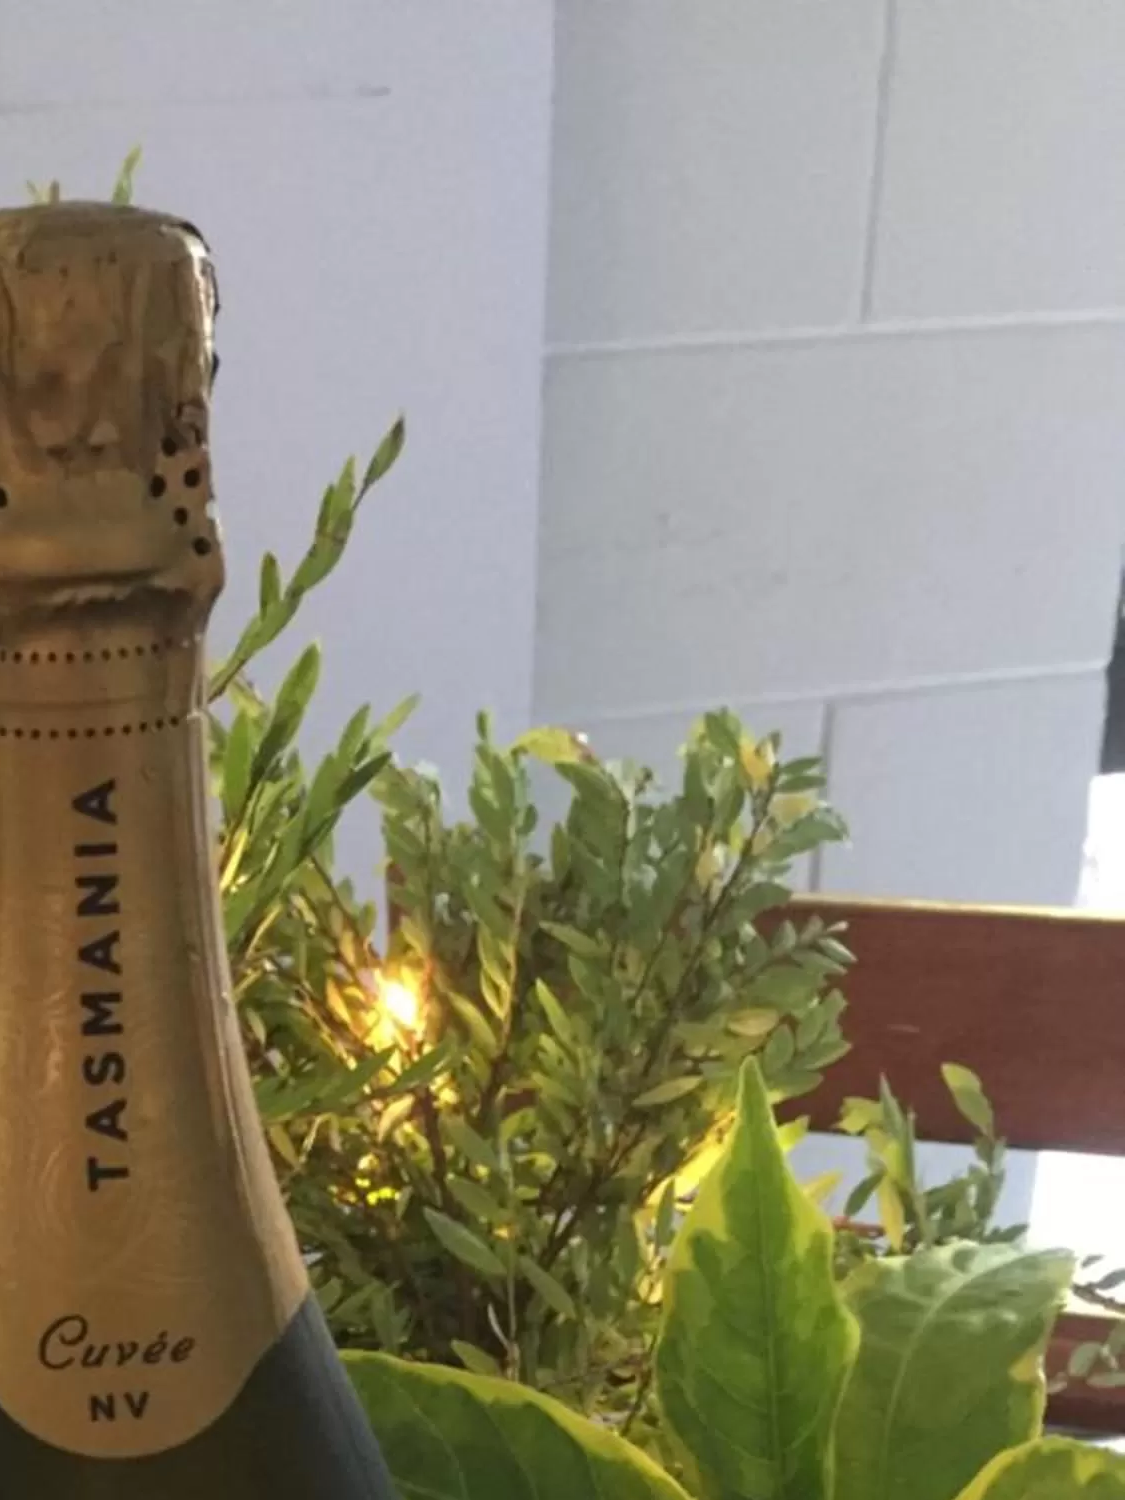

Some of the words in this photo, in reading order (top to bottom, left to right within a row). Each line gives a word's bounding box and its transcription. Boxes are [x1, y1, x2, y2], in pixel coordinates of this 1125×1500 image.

[72, 778, 131, 1192] TASMANIA
[38, 1313, 197, 1371] Cuvée
[89, 1391, 150, 1422] NV
